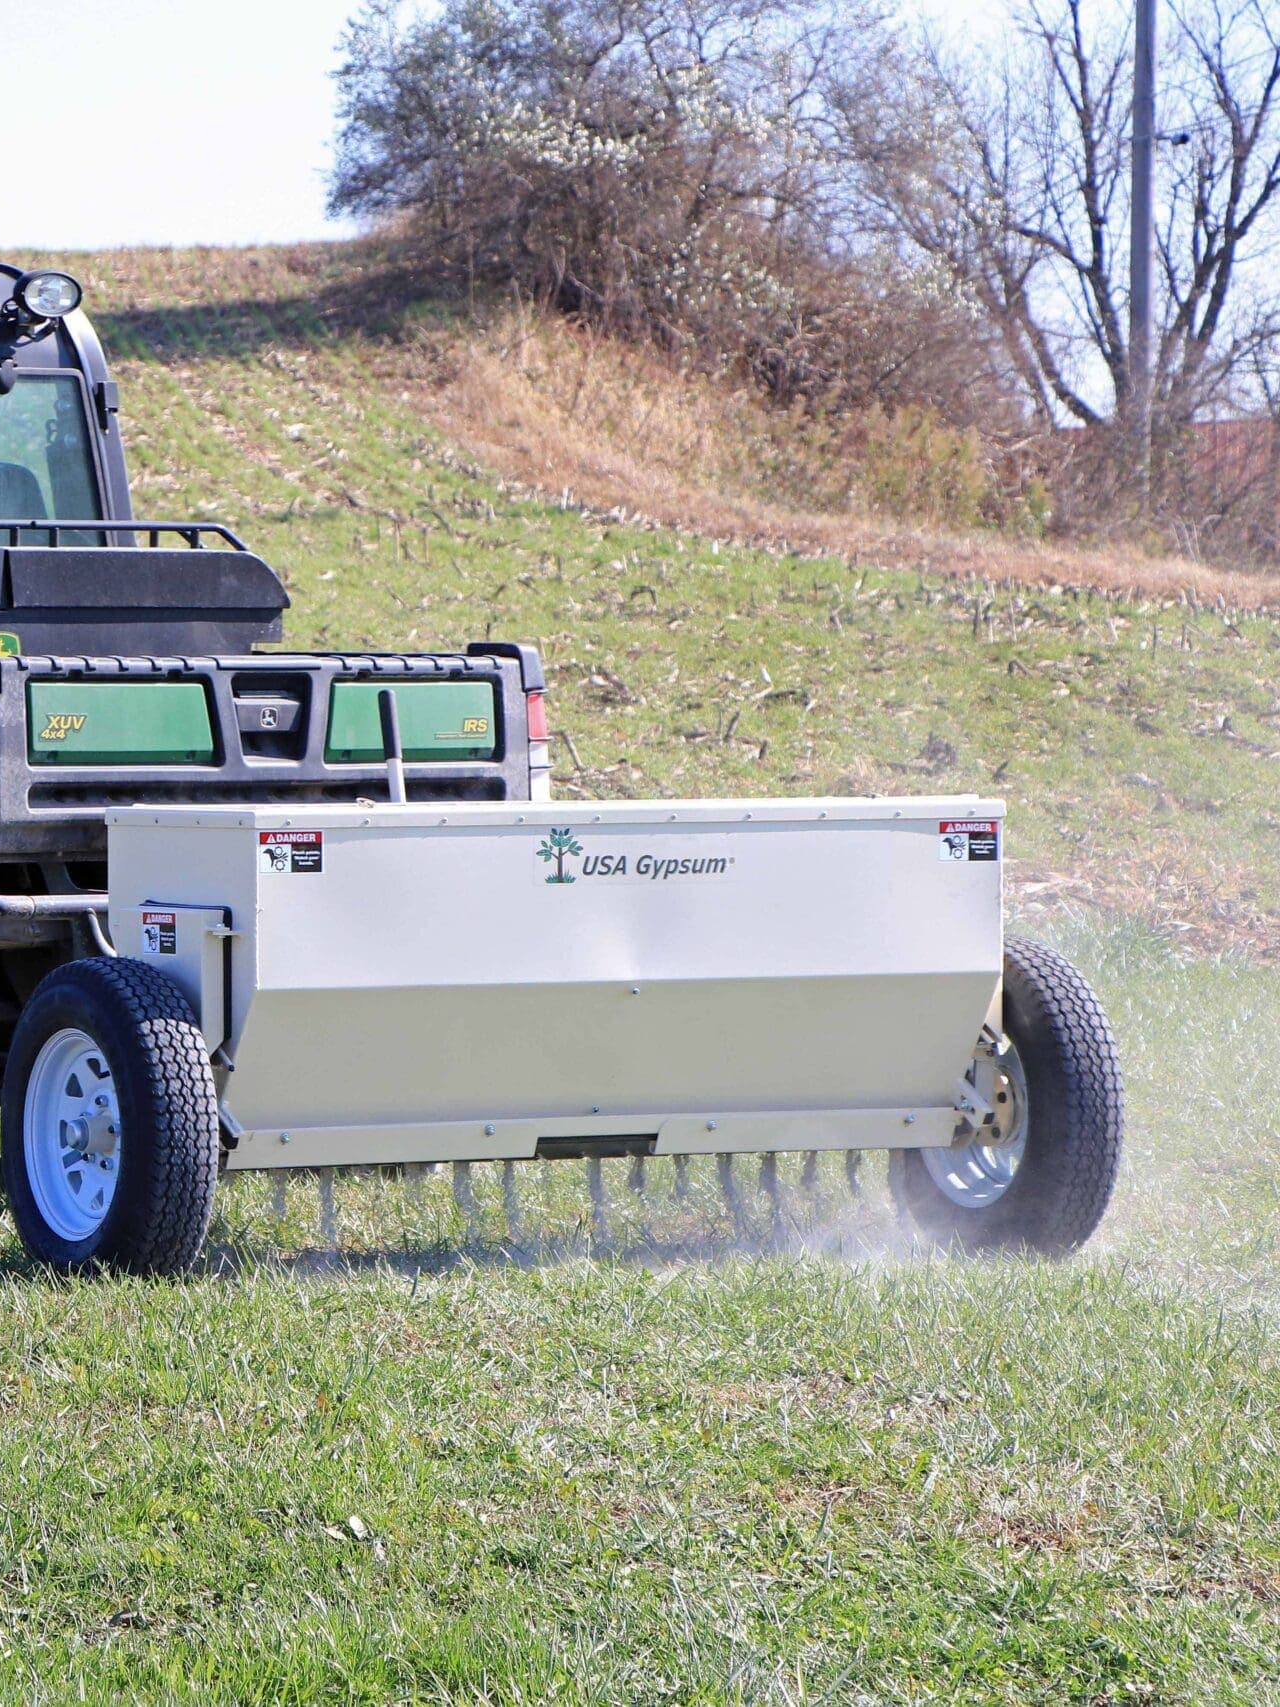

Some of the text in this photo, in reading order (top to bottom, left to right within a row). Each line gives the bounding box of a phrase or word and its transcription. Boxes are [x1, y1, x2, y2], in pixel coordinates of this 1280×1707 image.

[47, 715, 86, 730] XUV
[463, 718, 488, 732] IRS
[40, 729, 66, 739] 4x4
[954, 823, 992, 832] DANGER
[276, 833, 316, 843] DANGER
[582, 855, 627, 876] USA
